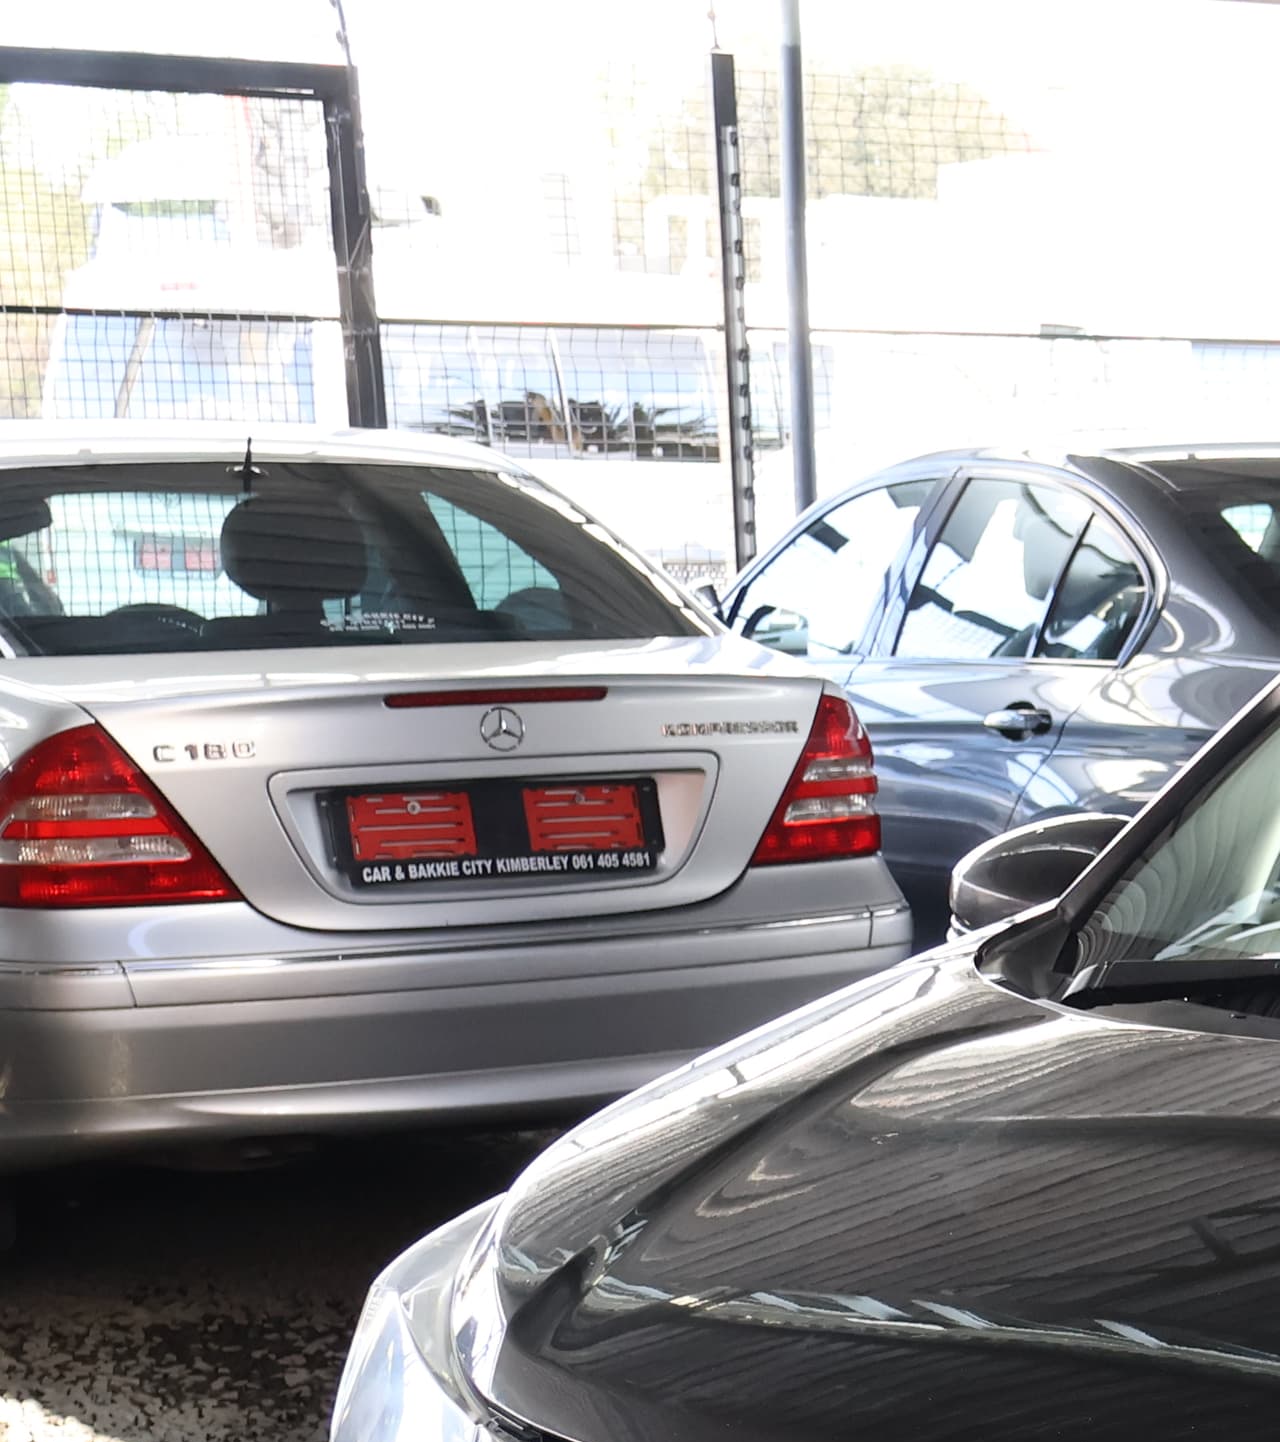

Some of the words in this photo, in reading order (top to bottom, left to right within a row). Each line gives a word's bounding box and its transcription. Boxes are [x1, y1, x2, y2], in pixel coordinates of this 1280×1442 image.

[152, 744, 176, 763] C
[183, 741, 257, 761] 180
[362, 866, 392, 883] CAR
[394, 864, 406, 881] &
[408, 862, 460, 880] BAKKIE
[462, 859, 493, 876] CITY
[495, 855, 569, 873] KIMBERLEY
[571, 853, 594, 870] 061
[597, 852, 620, 868] 405
[622, 851, 650, 867] 4581
